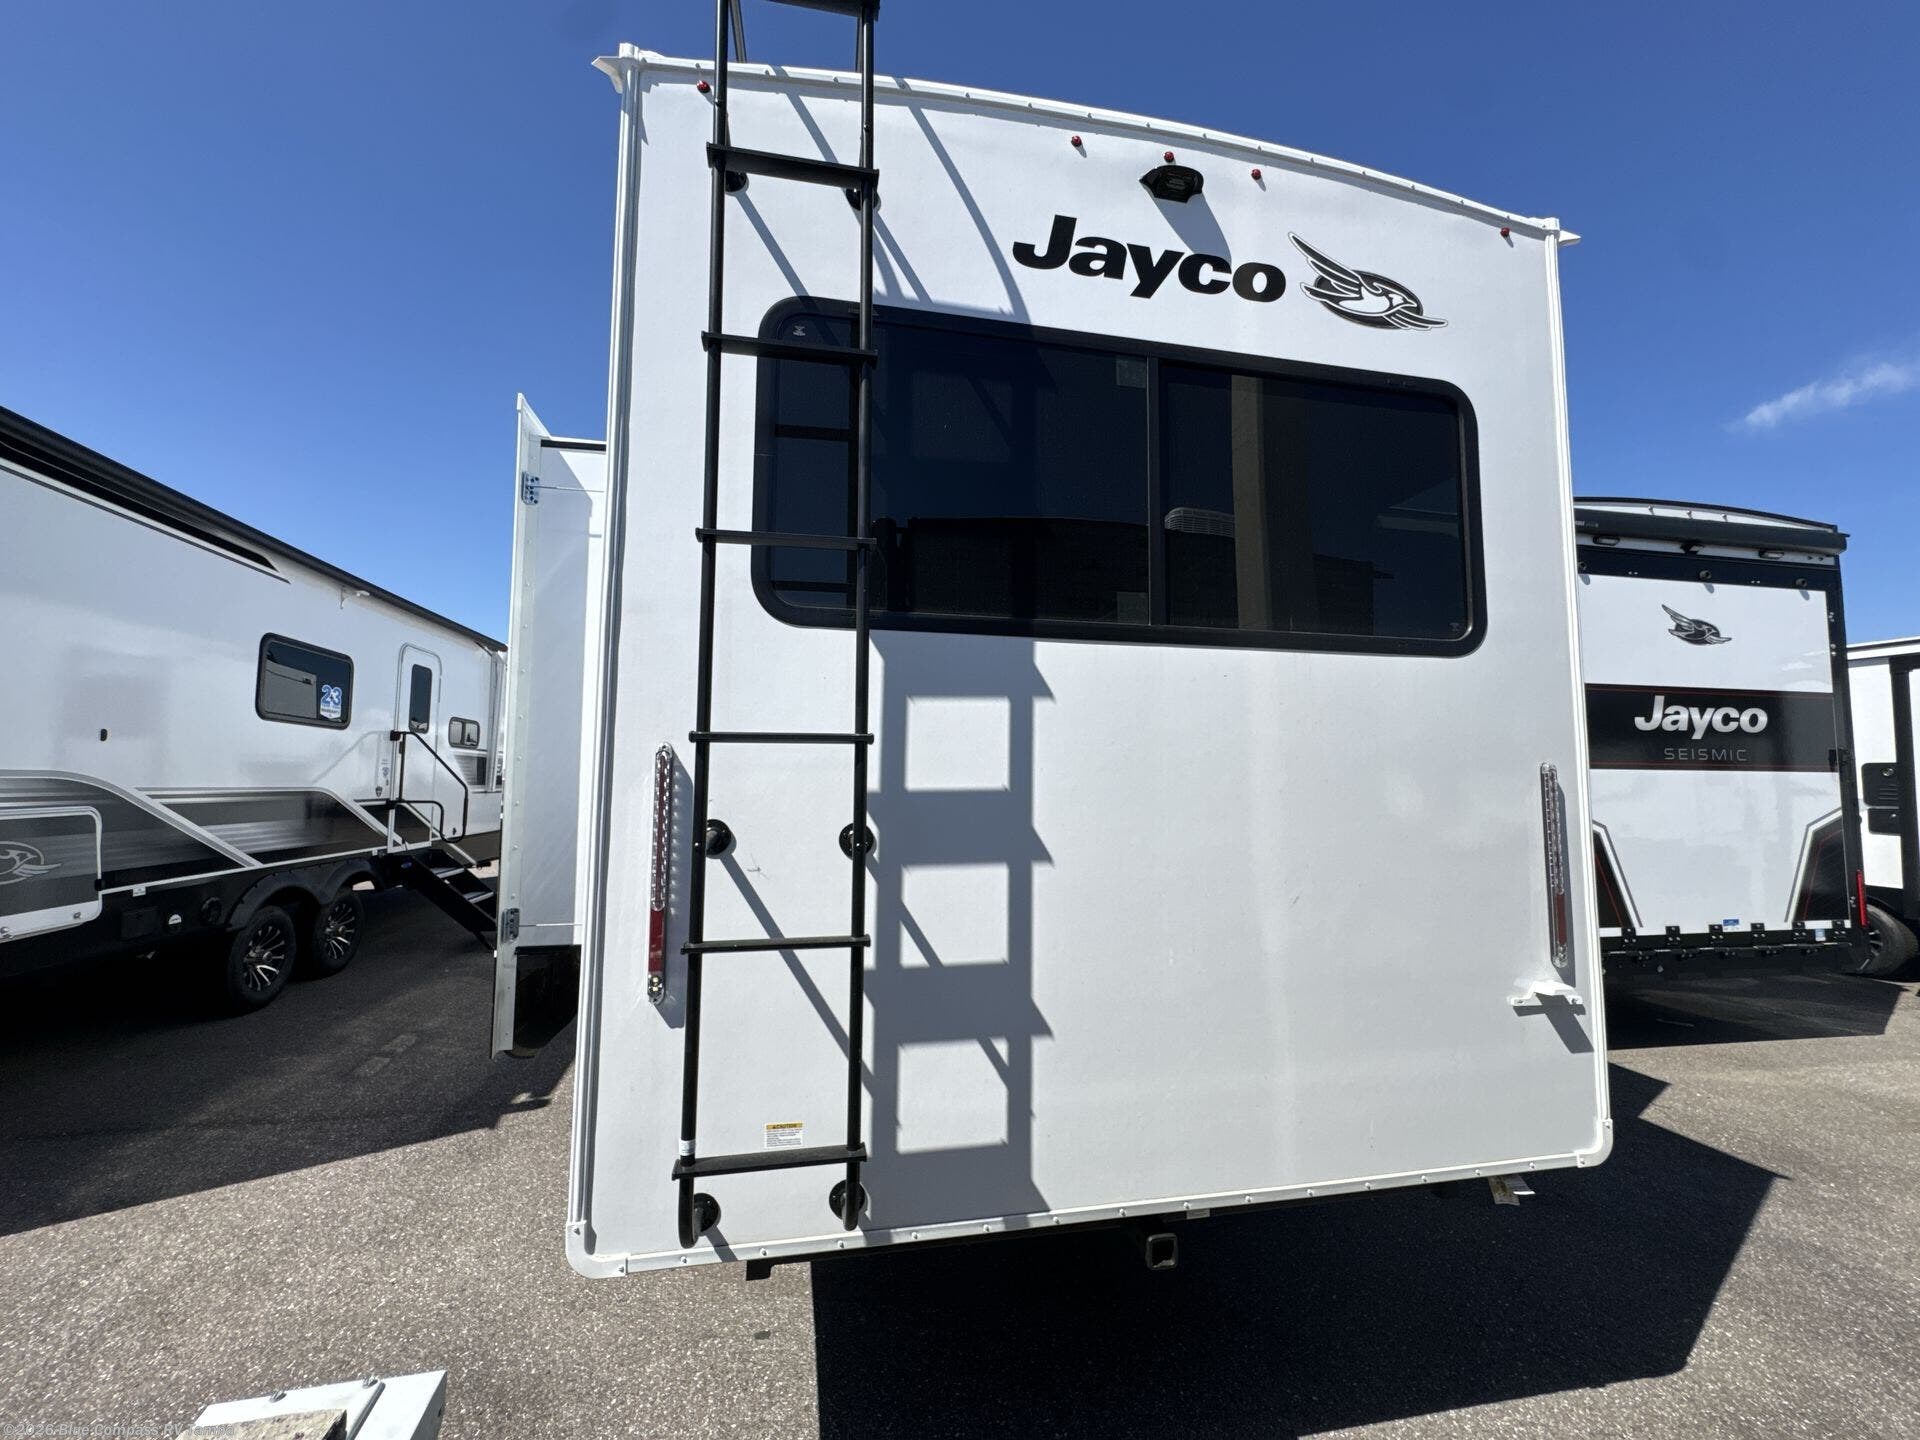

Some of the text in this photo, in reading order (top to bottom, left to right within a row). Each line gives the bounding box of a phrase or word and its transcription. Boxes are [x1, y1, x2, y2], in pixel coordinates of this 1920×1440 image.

[1012, 214, 1286, 302] Jayco
[1634, 695, 1768, 740] Jayco
[1664, 747, 1748, 762] SEISMIC
